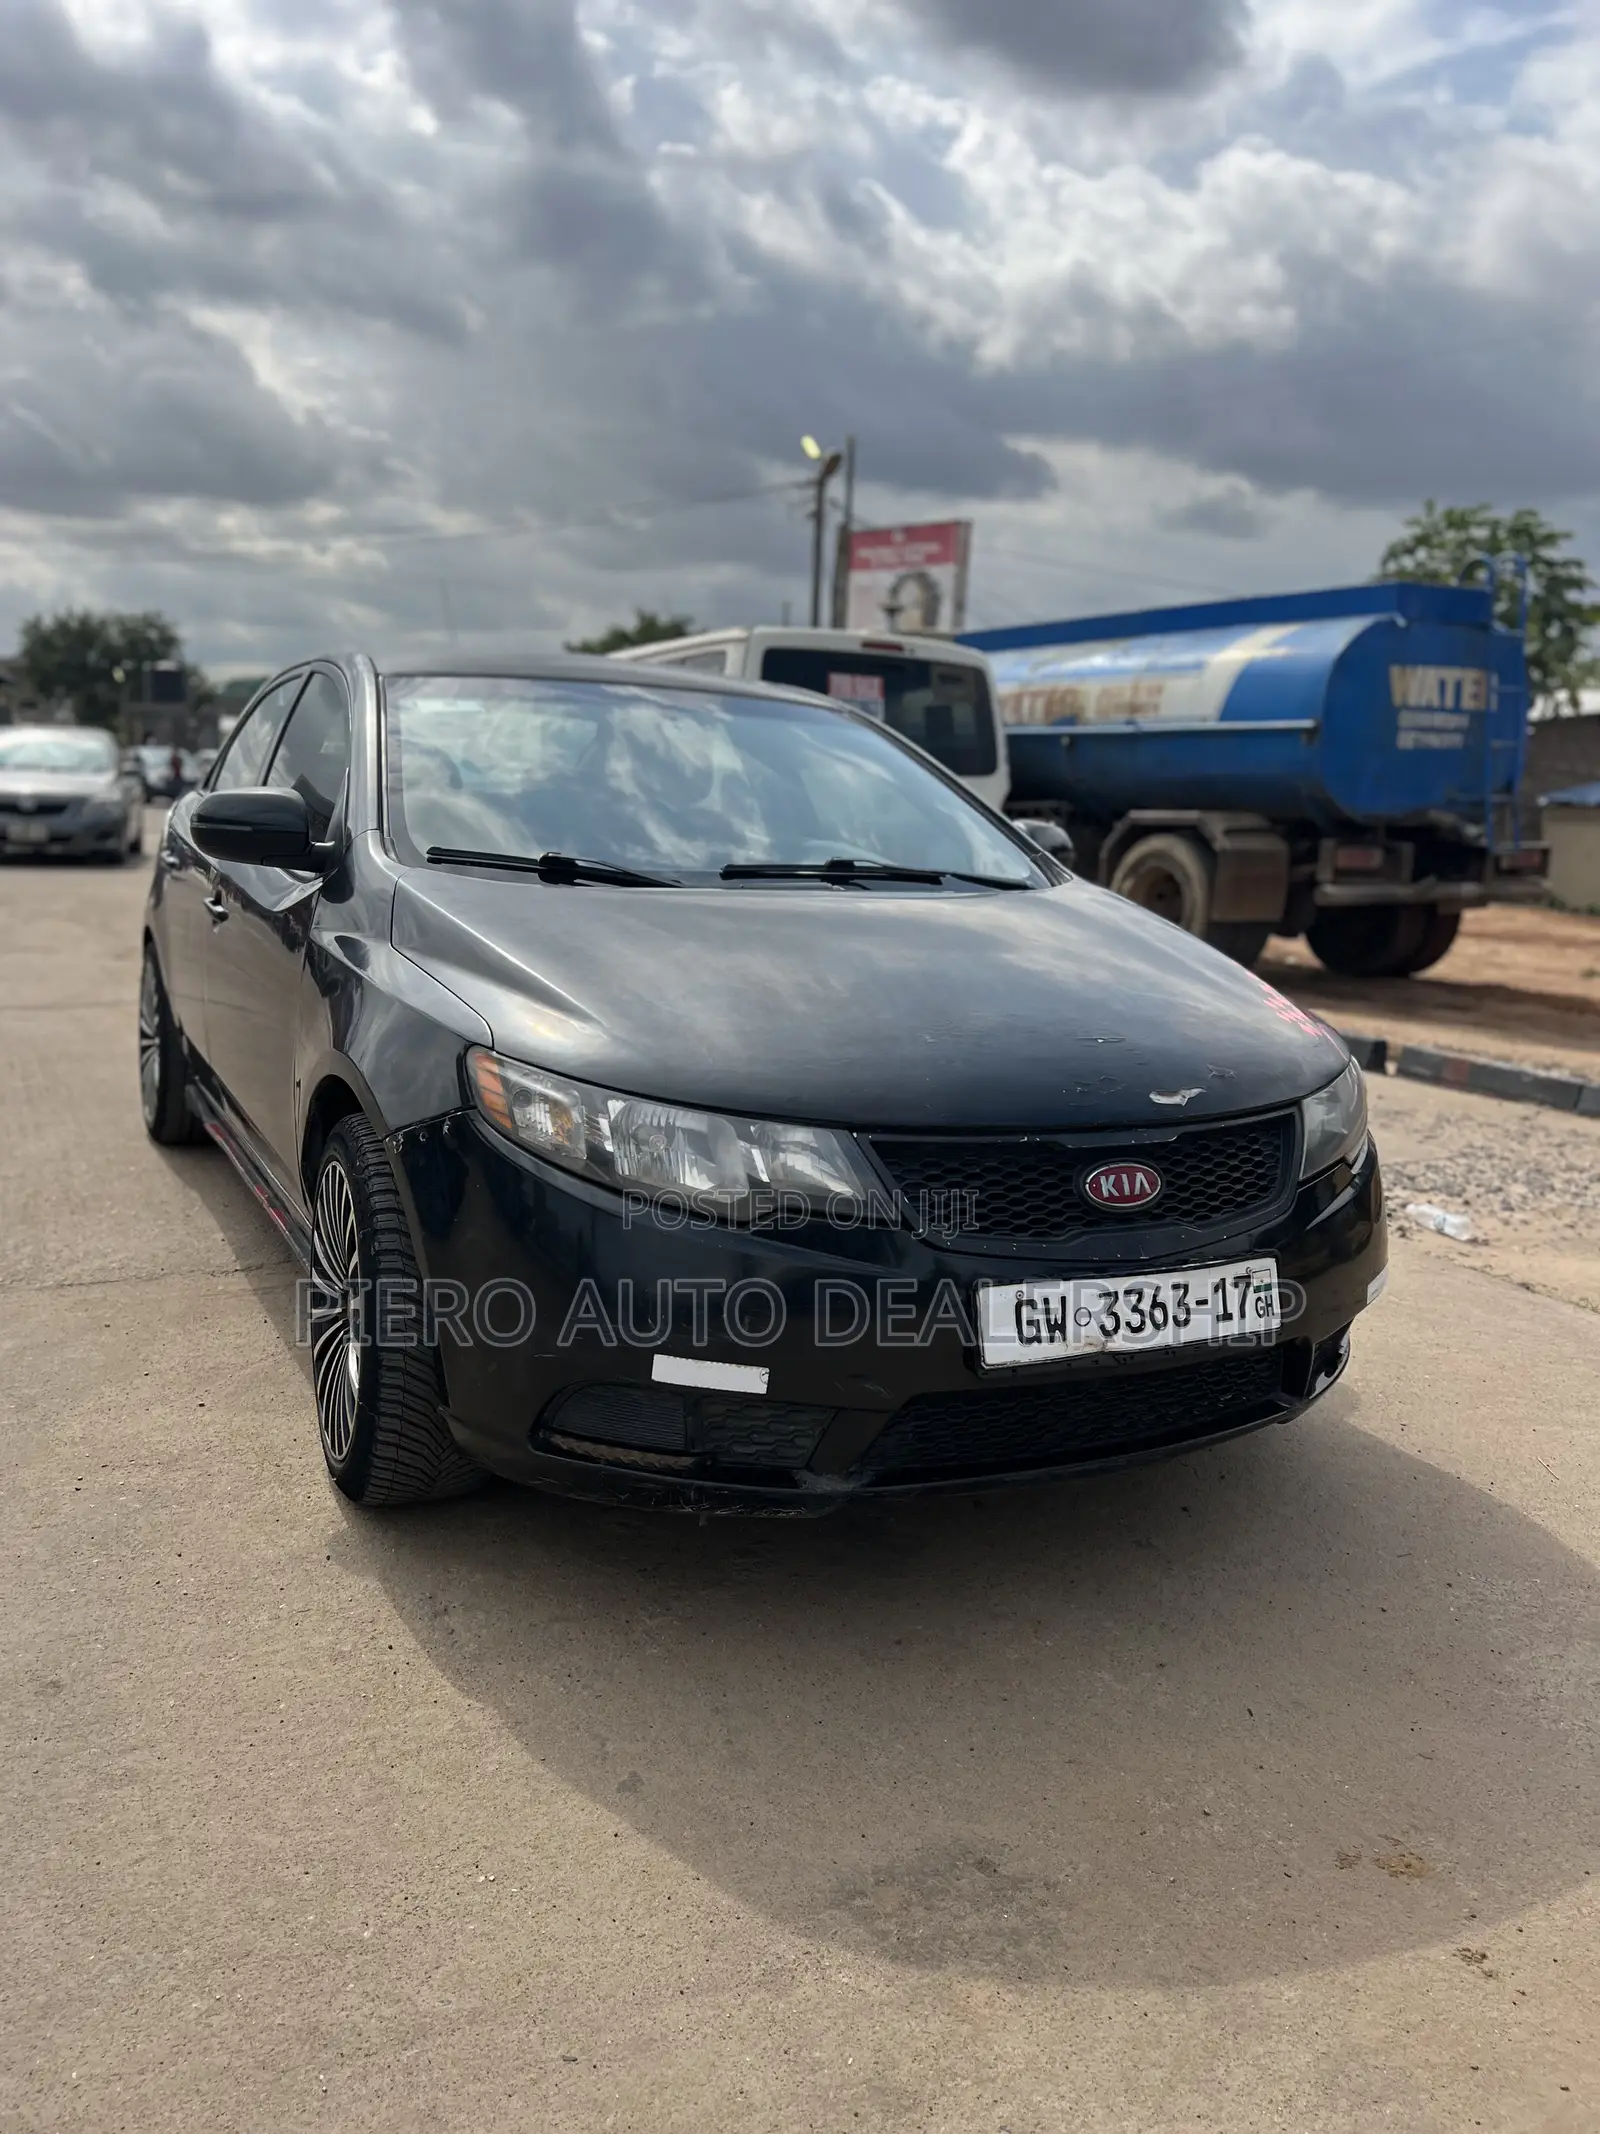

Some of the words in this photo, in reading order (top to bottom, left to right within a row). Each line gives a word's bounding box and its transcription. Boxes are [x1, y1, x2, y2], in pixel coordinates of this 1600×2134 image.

[1098, 1172, 1153, 1199] KIA
[1014, 1295, 1068, 1347] GW
[1098, 1272, 1252, 1338] 3363-17
[1255, 1294, 1275, 1319] GH
